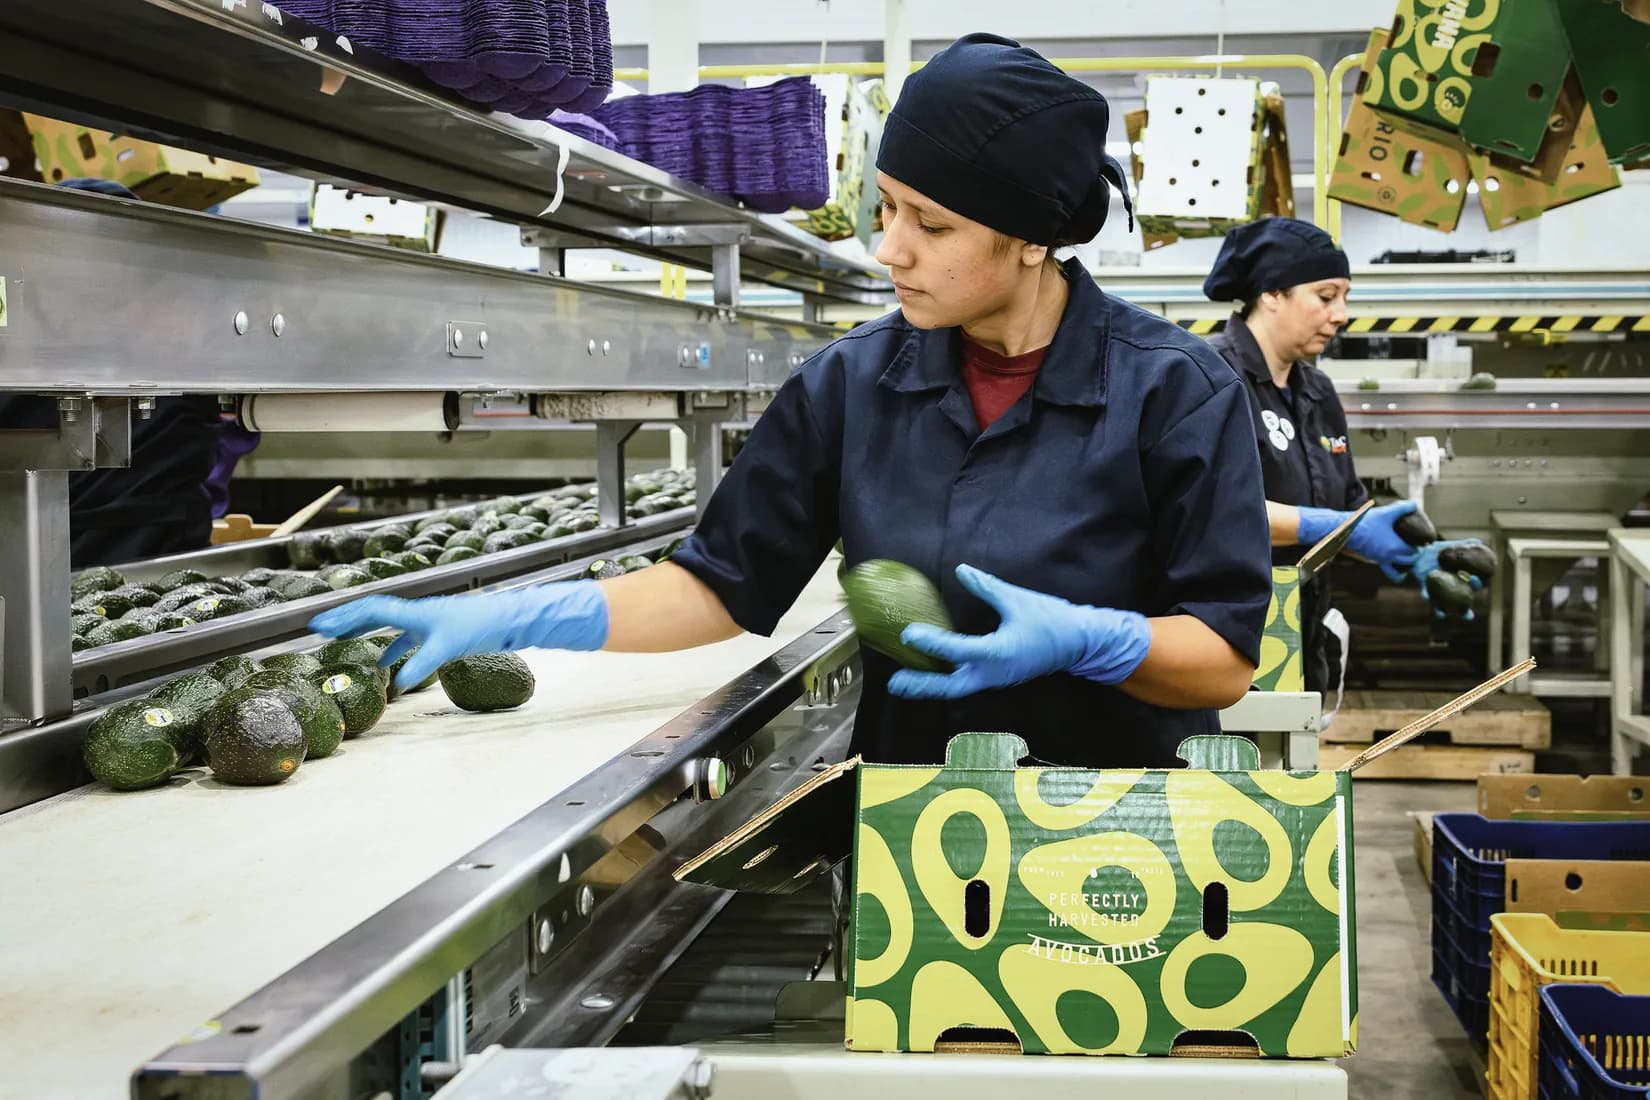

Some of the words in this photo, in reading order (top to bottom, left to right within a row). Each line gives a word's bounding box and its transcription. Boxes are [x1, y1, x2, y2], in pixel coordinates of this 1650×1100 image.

[1048, 893, 1139, 908] PERFECTLY
[1048, 913, 1139, 927] HARVESTED
[1028, 936, 1161, 965] AVOCADOS
